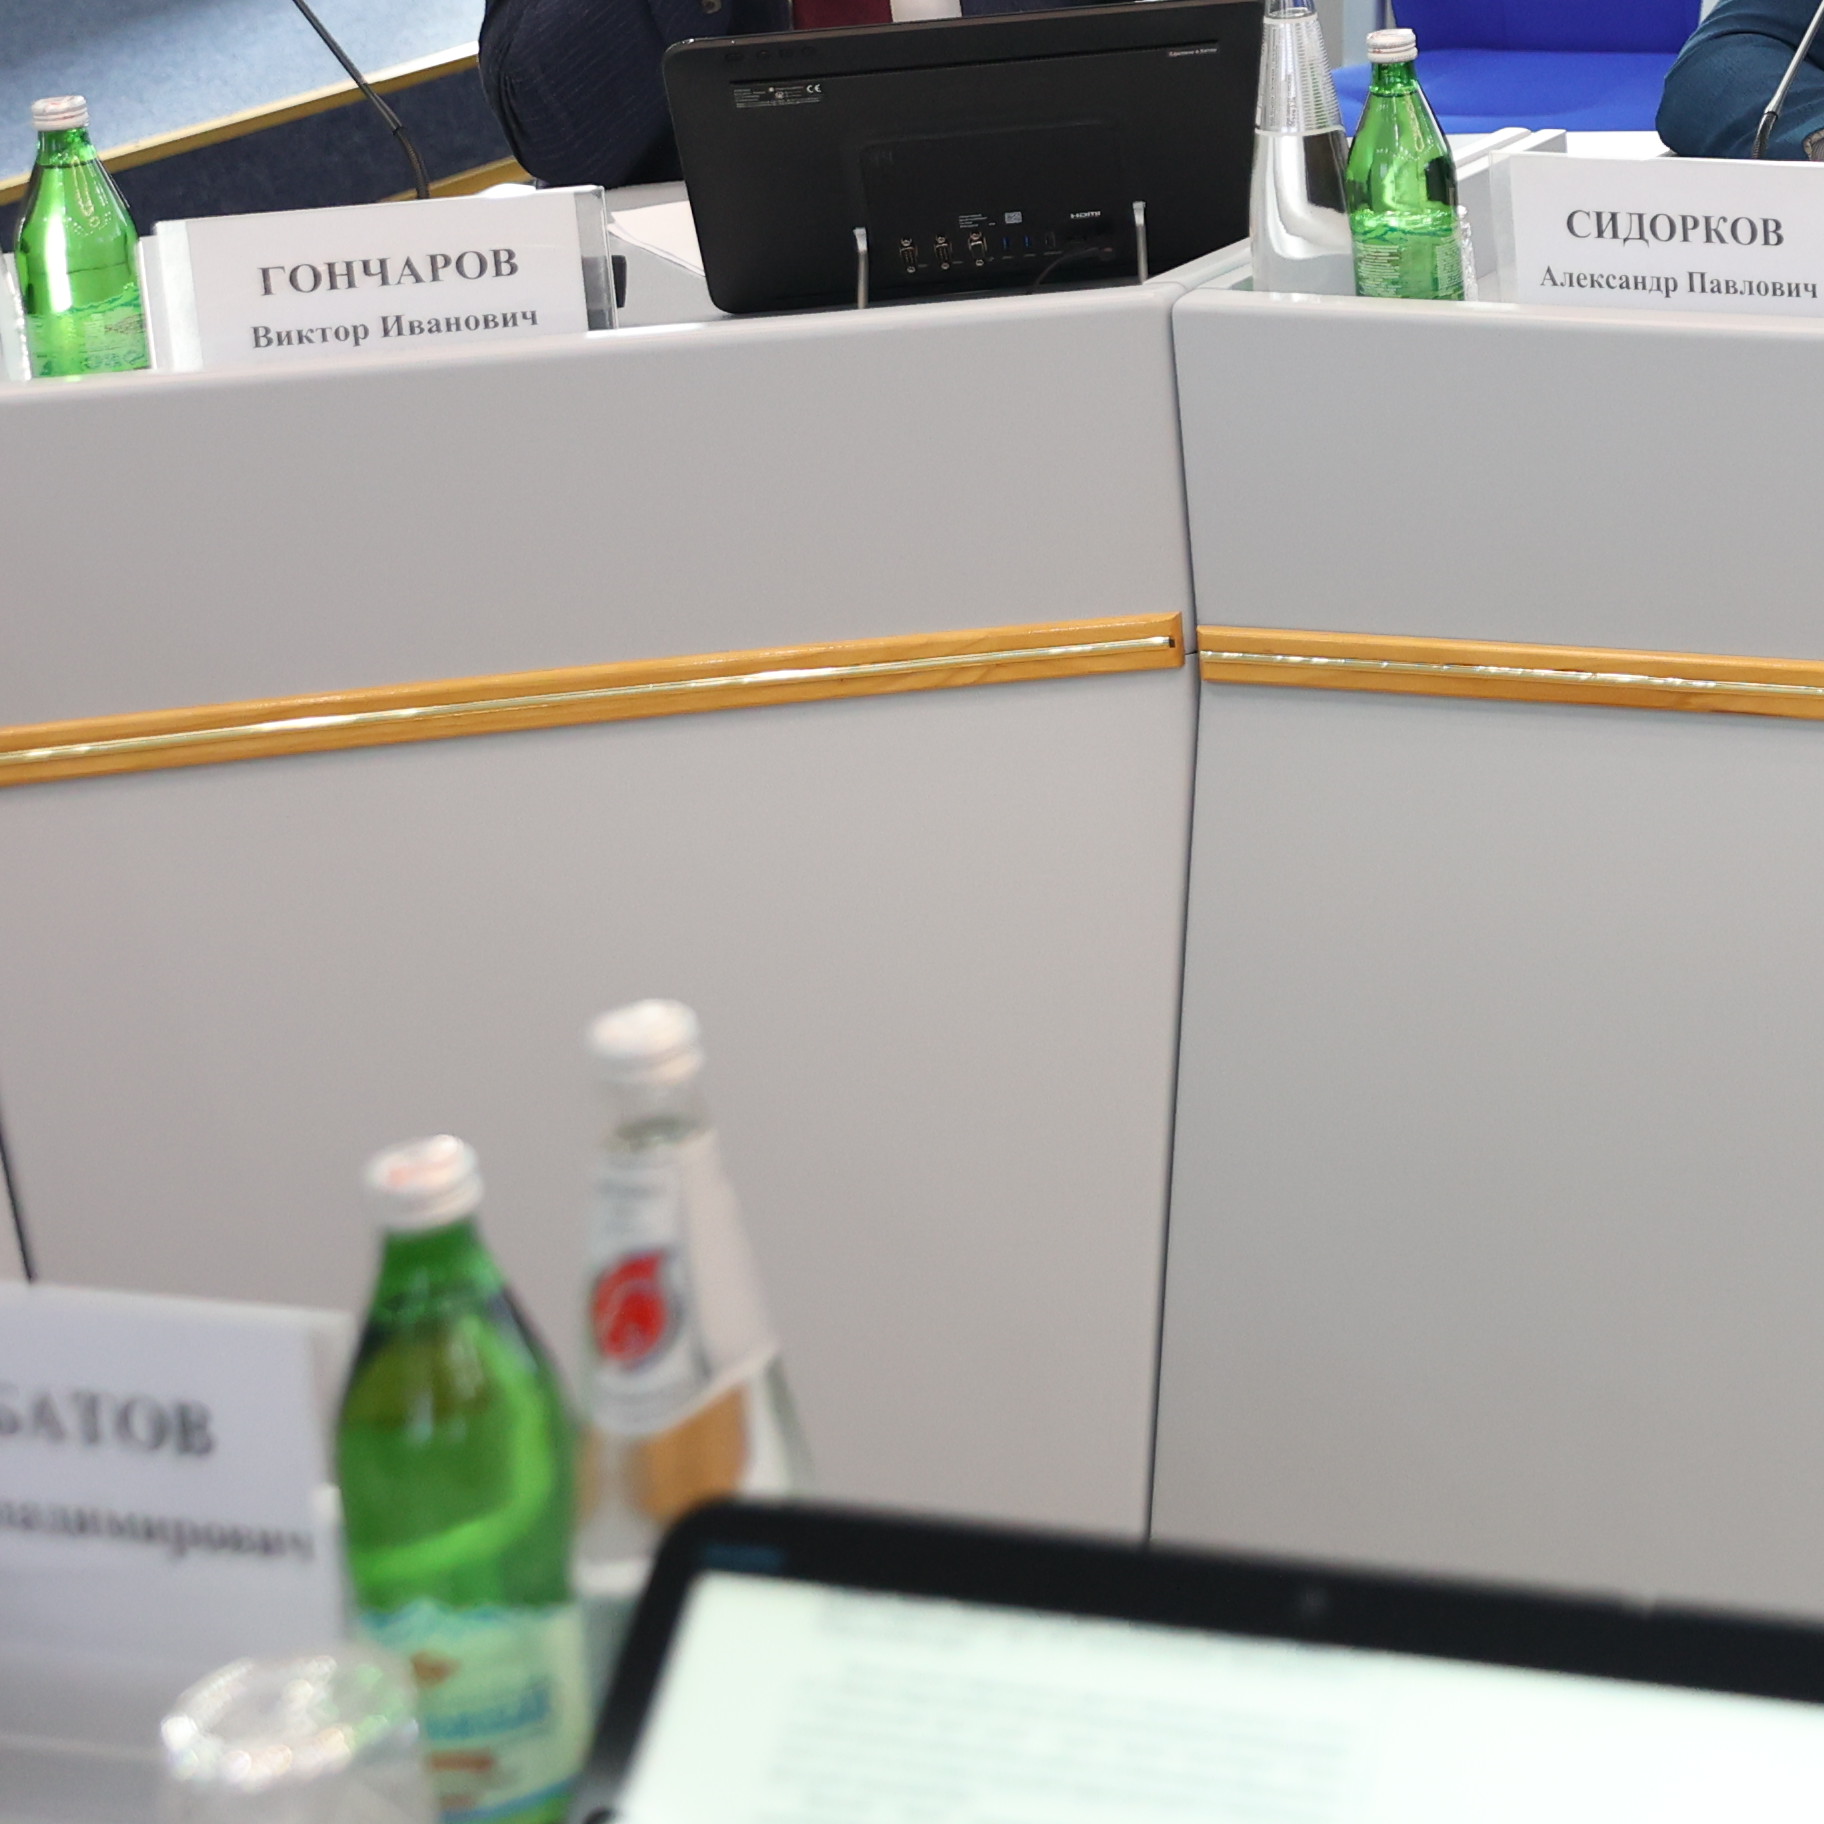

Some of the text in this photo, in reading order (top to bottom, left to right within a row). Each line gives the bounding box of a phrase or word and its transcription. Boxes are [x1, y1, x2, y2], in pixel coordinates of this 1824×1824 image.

[1566, 209, 1785, 248] СИДОРКОВ
[257, 248, 520, 297] ГОНЧАРОВ
[1540, 265, 1818, 299] Александр Павлович
[251, 309, 539, 349] Виктор Иванович
